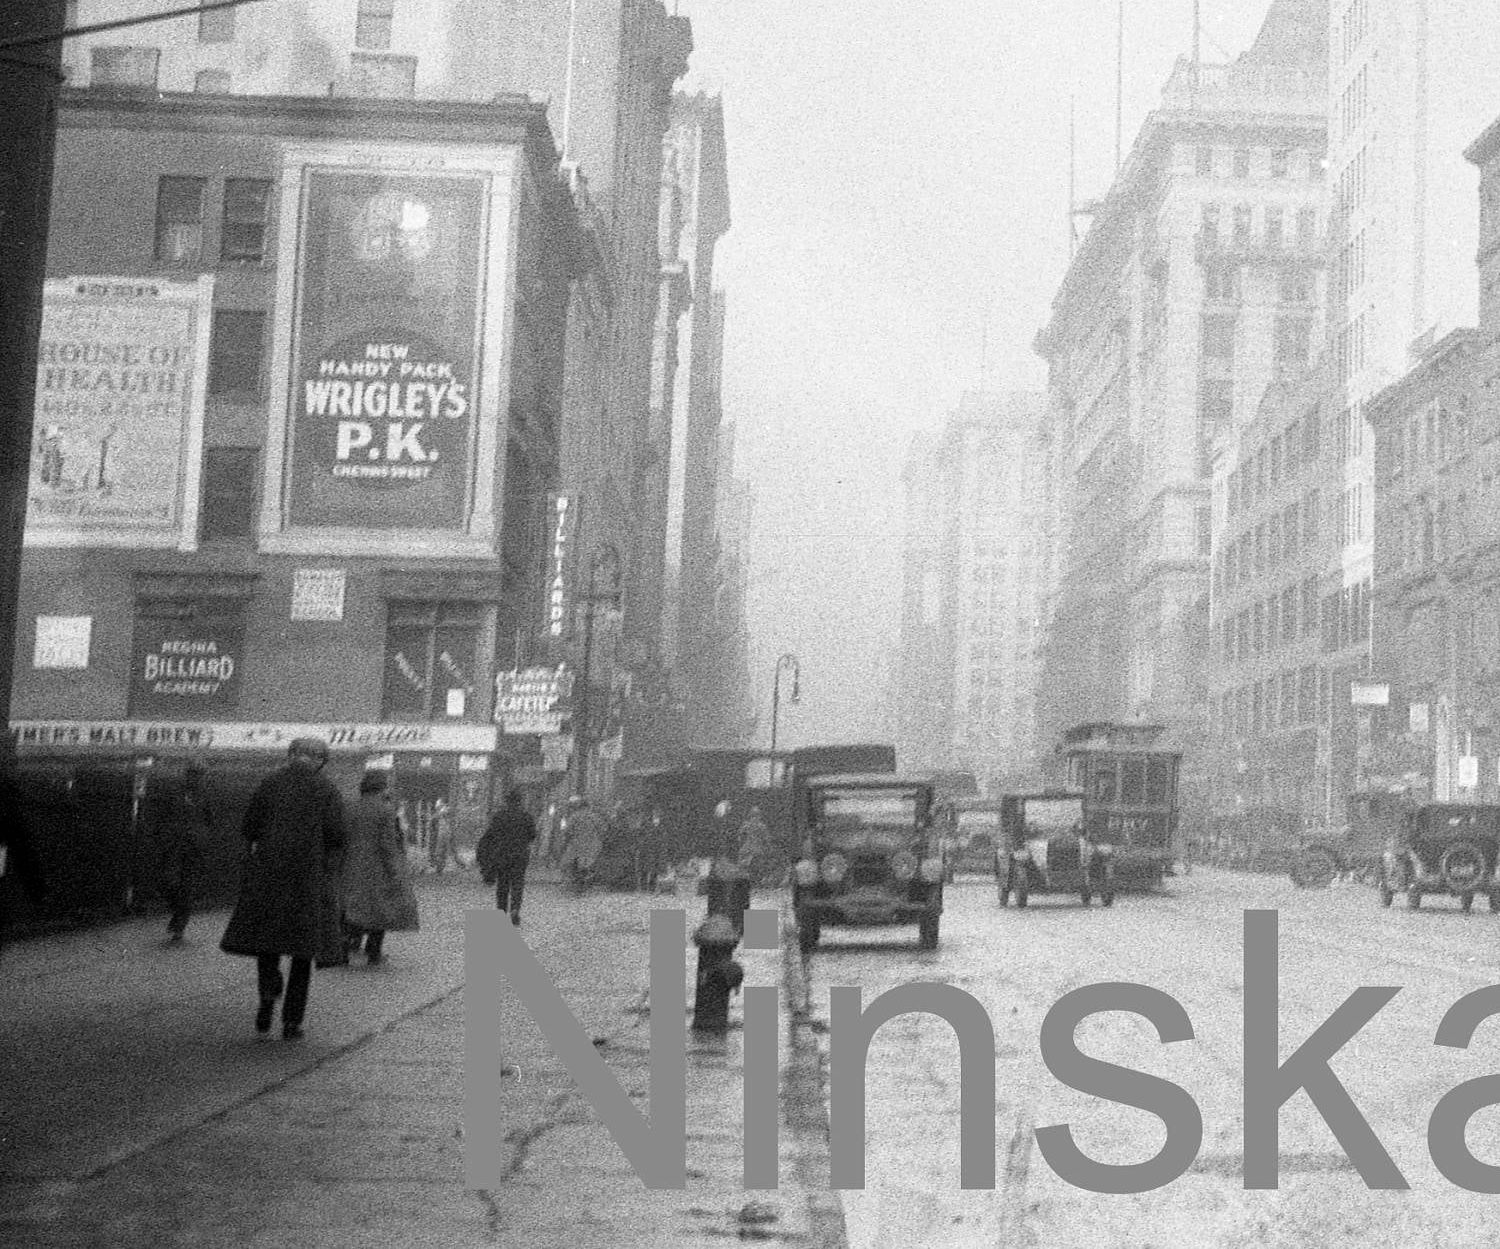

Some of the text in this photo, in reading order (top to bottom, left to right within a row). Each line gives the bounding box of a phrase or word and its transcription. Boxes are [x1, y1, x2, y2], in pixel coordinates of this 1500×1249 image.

[366, 344, 409, 359] NEW
[320, 360, 452, 378] HANDY PACK
[44, 368, 177, 392] HEALTH
[306, 377, 467, 419] WRIGLEY'S
[337, 420, 439, 462] P.K.
[551, 497, 568, 636] BILLIARDS
[161, 641, 218, 655] REGINA
[145, 654, 234, 681] BILLIARD
[153, 681, 221, 696] ACADEMY
[90, 727, 138, 746] MALT
